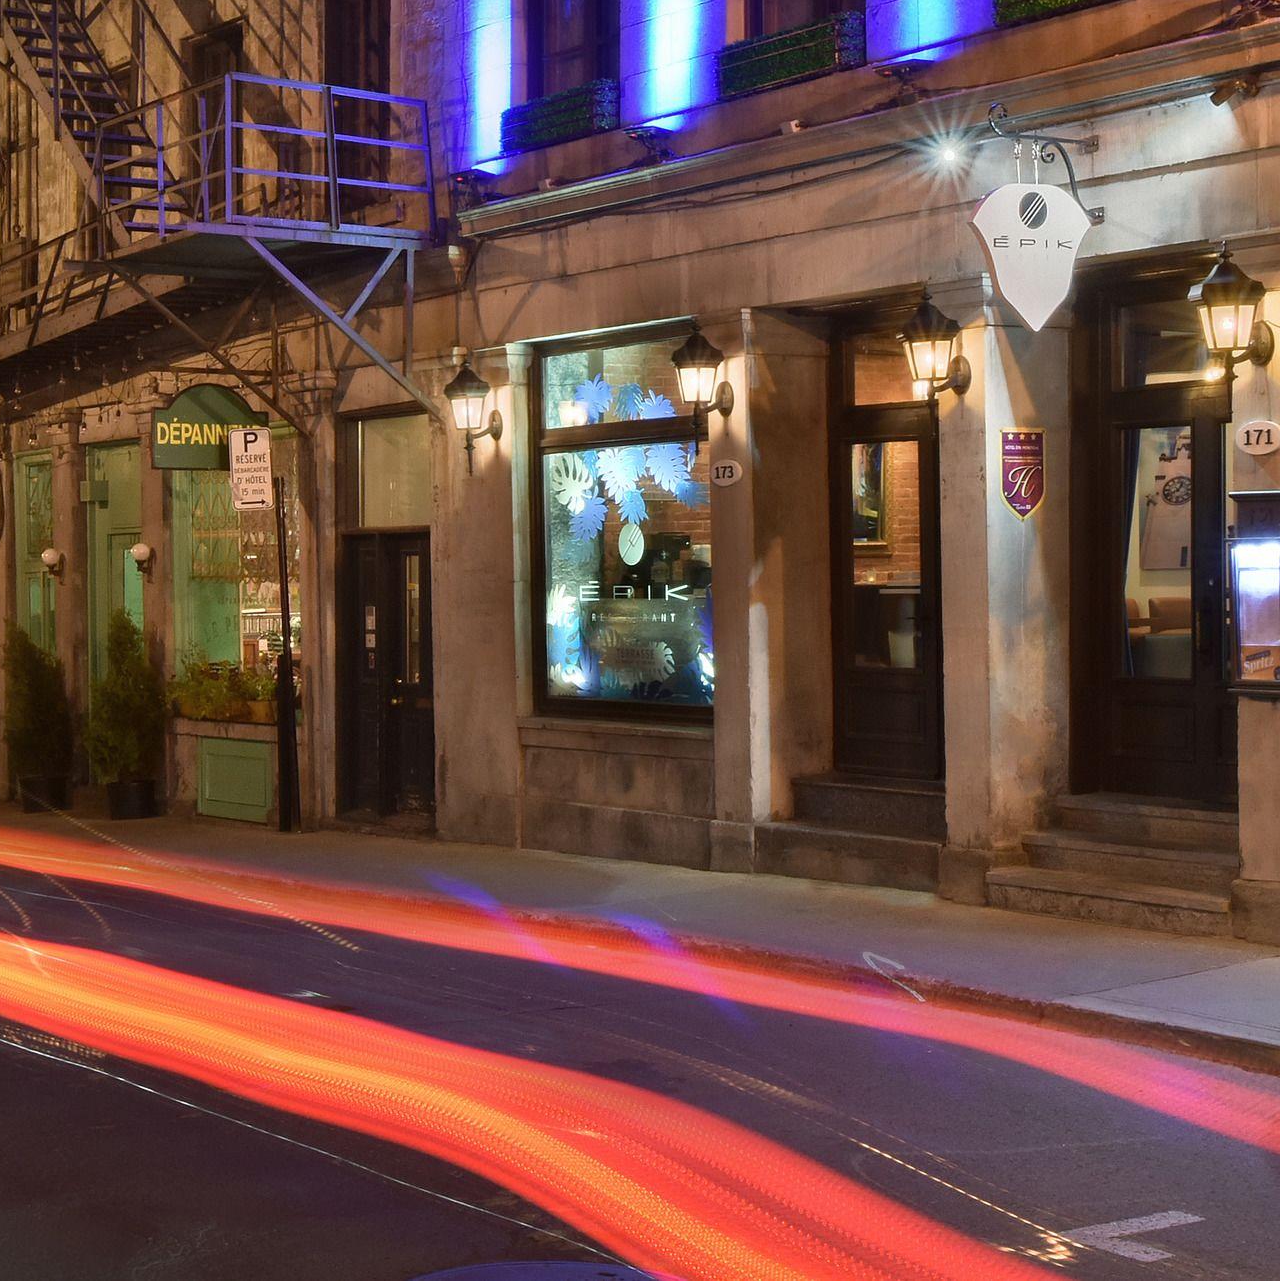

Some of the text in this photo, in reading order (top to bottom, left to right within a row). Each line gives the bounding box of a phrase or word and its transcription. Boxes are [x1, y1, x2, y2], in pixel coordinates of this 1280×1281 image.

[993, 235, 1073, 249] ÉPIK
[156, 417, 260, 446] DÉPANN
[1243, 428, 1274, 446] 171
[243, 432, 258, 453] P
[235, 452, 267, 464] RÉSERVÉ
[714, 465, 734, 480] 173
[245, 475, 268, 485] HÔTEL
[241, 488, 249, 496] 15
